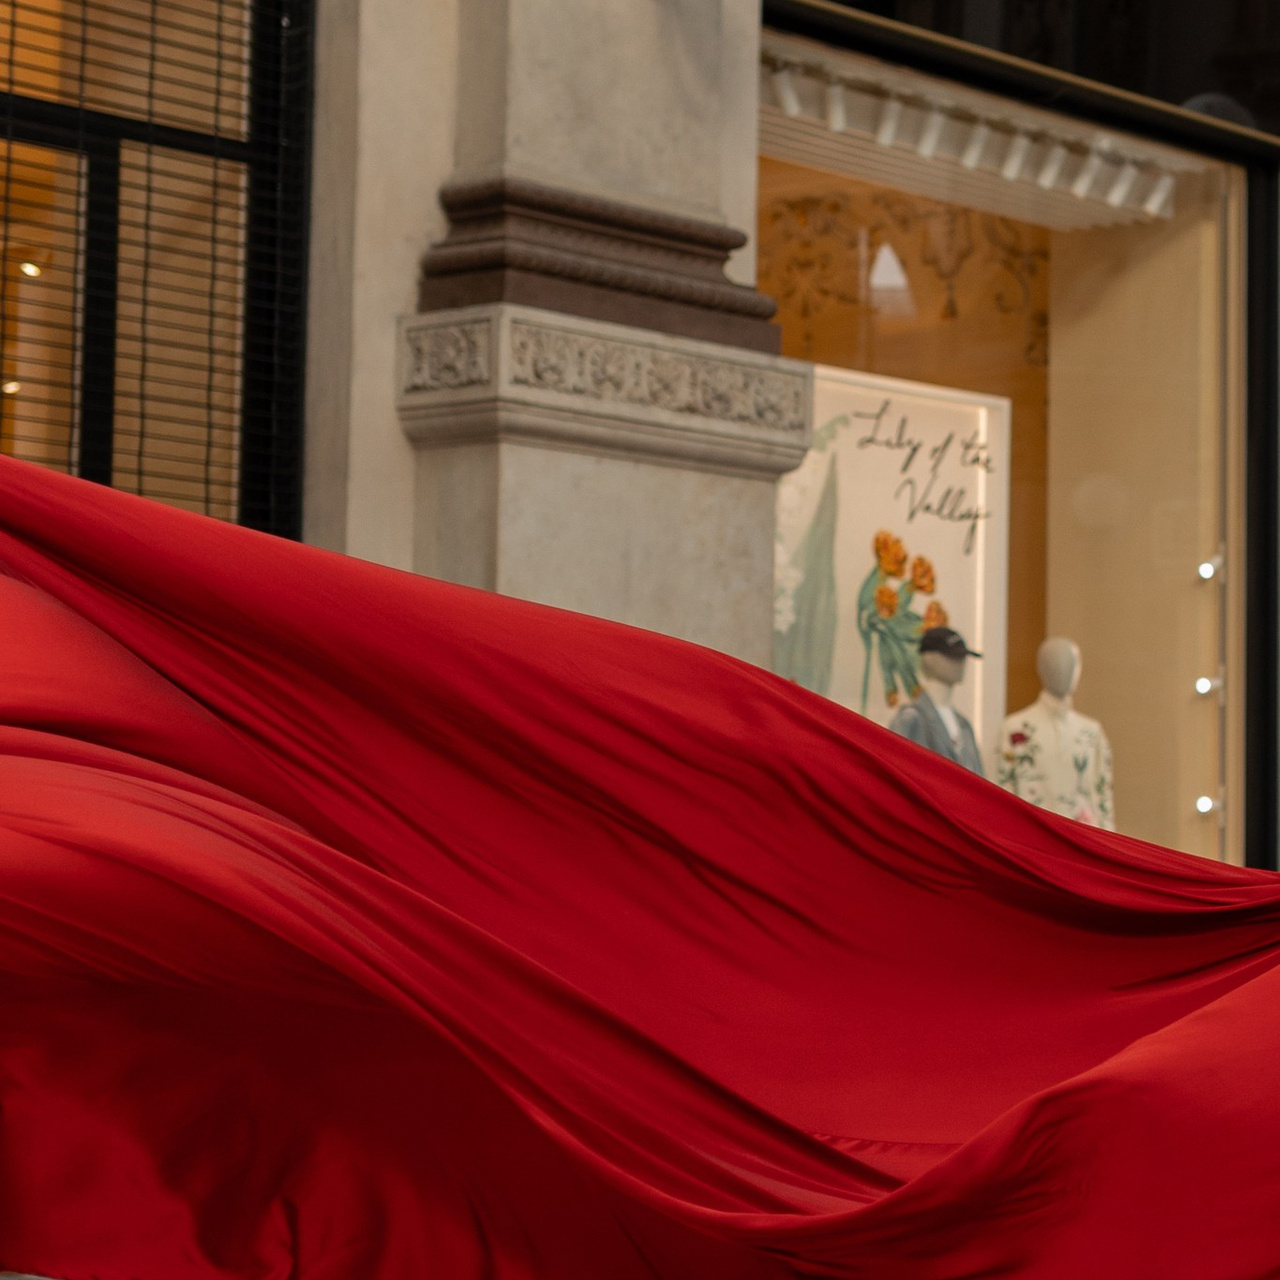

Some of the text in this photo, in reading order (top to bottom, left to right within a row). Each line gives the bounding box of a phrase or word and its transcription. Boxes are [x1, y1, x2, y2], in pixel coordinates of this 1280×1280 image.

[852, 398, 996, 478] Lily of the
[893, 475, 992, 556] Valley
